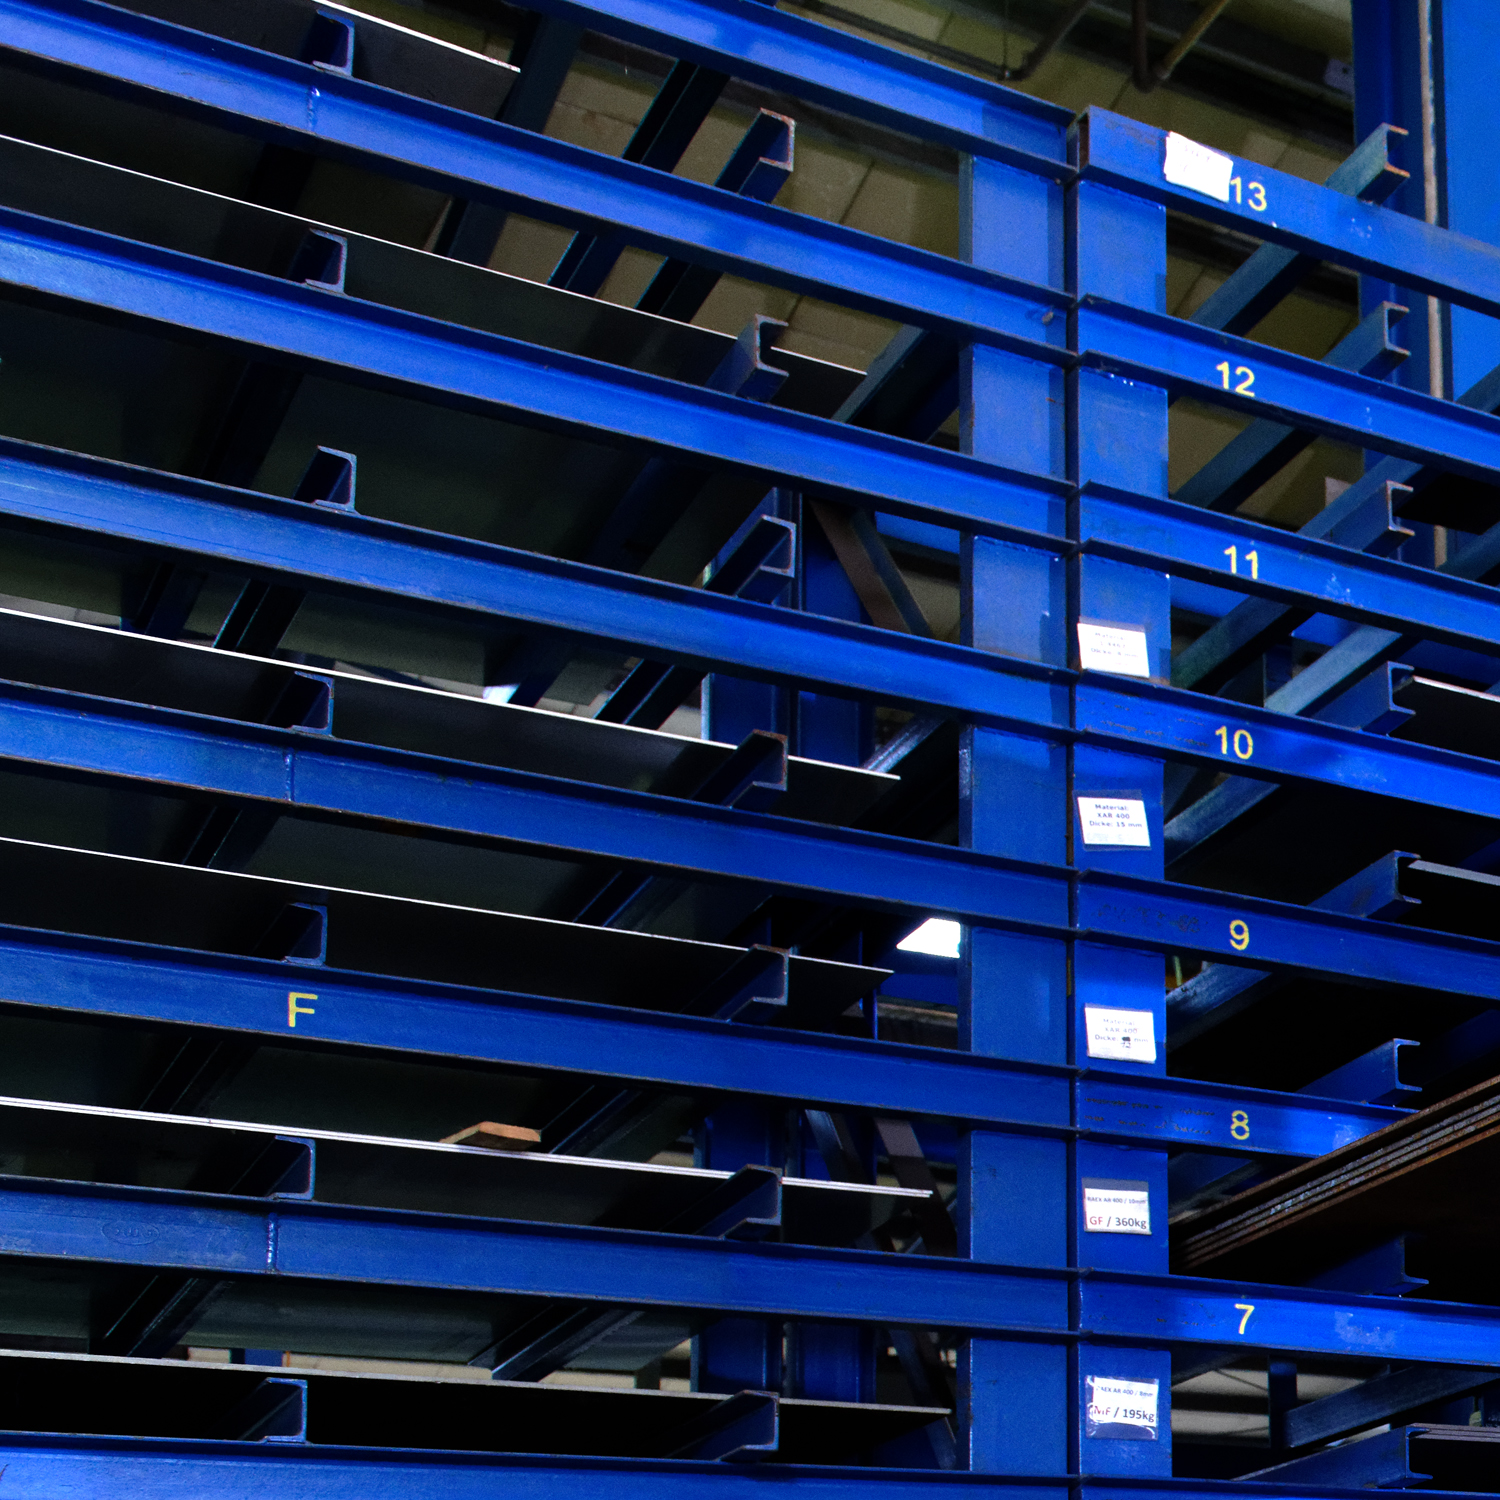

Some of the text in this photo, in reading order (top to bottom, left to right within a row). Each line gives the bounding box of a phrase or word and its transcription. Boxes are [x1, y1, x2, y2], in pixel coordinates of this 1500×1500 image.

[1229, 176, 1267, 212] 13
[1216, 362, 1255, 397] 12
[1224, 546, 1259, 580] 11
[1216, 726, 1254, 760] 10
[1230, 919, 1250, 951] 9
[288, 992, 318, 1028] F
[1231, 1110, 1250, 1141] 8
[1089, 1216, 1103, 1226] GF
[1115, 1217, 1147, 1230] 360kg
[1235, 1304, 1255, 1335] 7
[1123, 1408, 1155, 1423] 195kg
